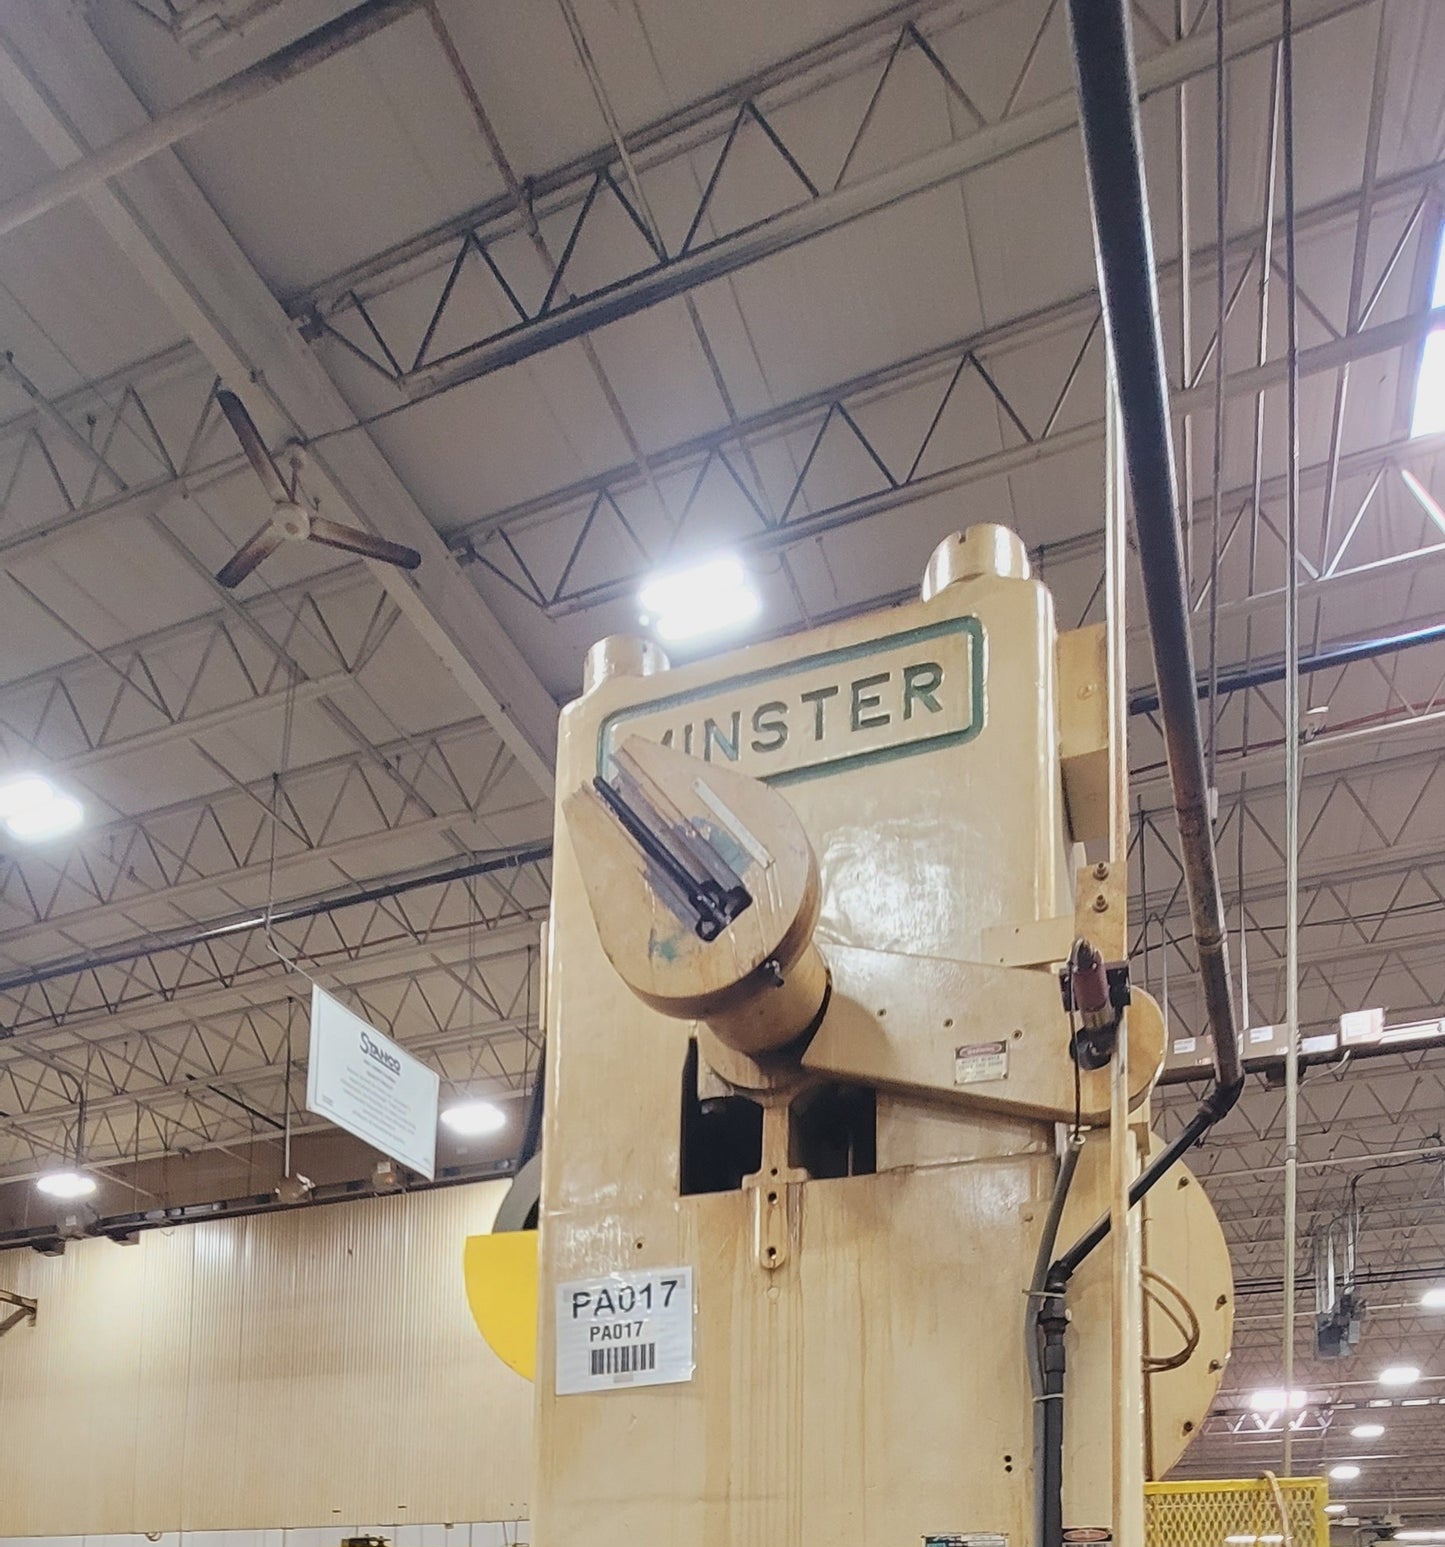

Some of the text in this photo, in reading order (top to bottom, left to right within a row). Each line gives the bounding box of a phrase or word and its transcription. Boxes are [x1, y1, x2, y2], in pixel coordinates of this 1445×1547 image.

[660, 660, 944, 763] INSTER
[572, 1280, 678, 1319] PA017
[590, 1321, 644, 1342] PA017
